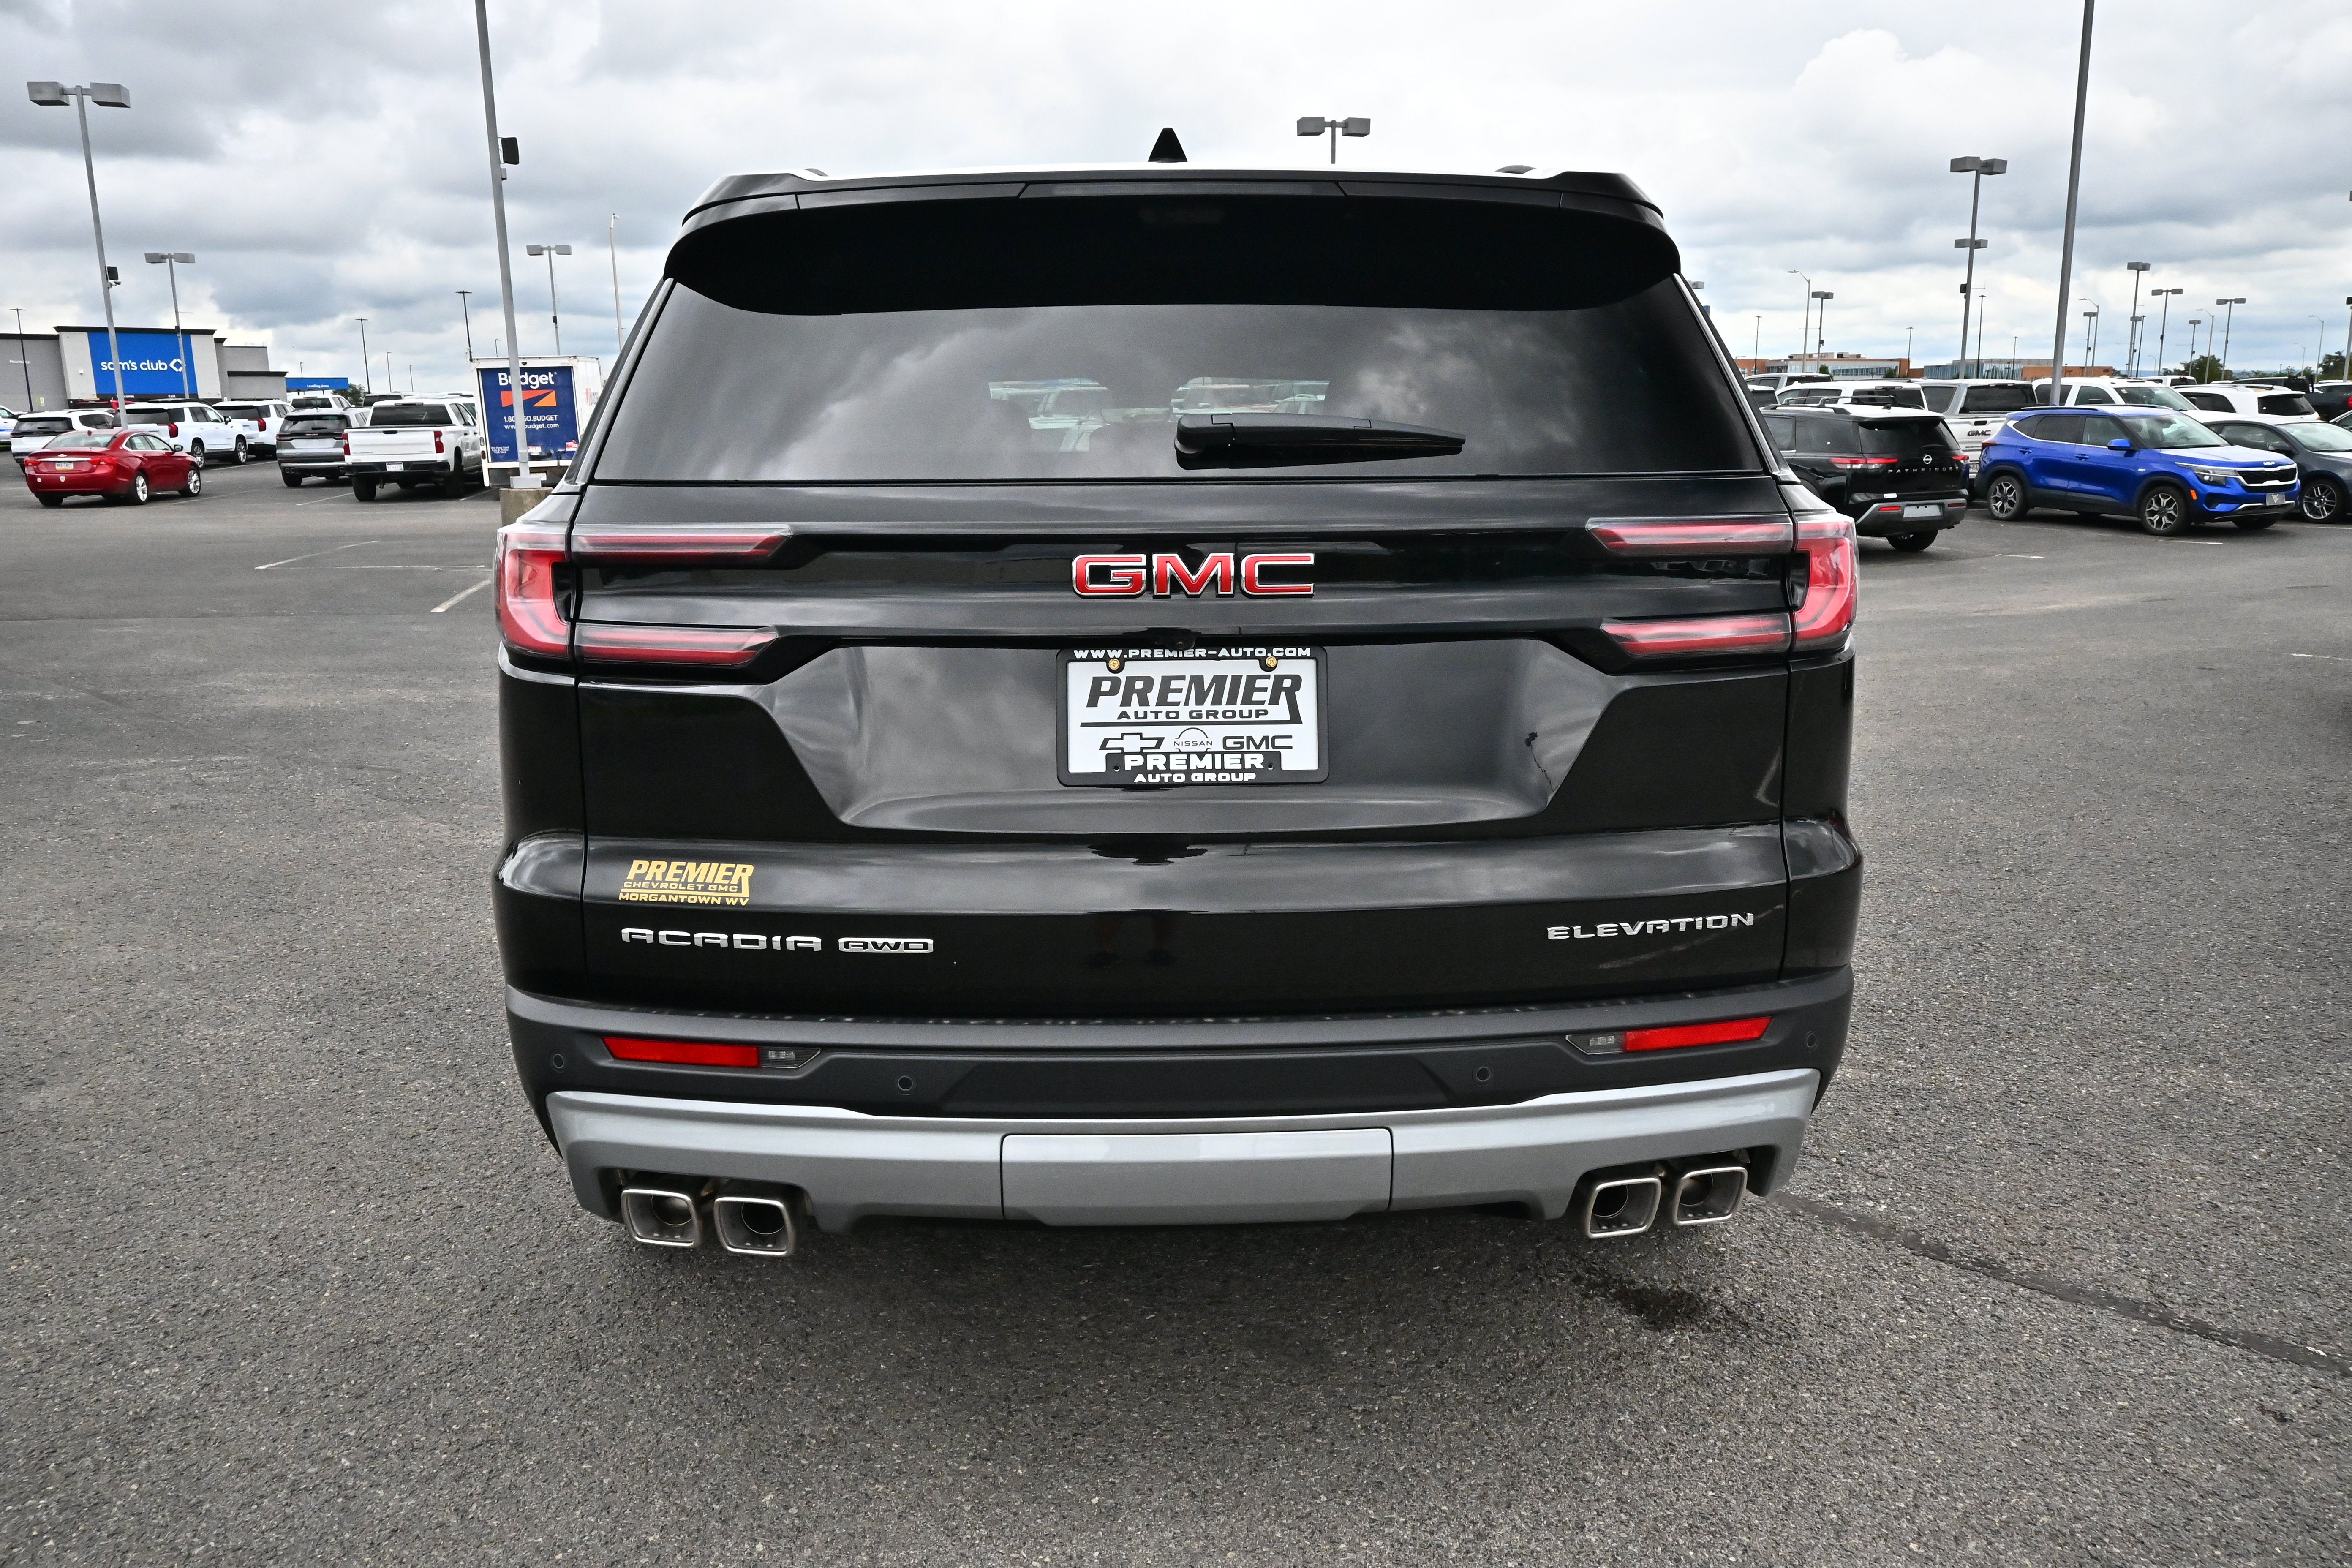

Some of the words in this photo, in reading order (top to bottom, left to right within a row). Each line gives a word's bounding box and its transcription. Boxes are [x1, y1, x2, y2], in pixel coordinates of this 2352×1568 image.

[140, 359, 168, 370] club
[498, 372, 554, 389] Bdget
[1071, 553, 1315, 597] GMC
[1073, 648, 1311, 658] WWW.PREMIER-AUTO.COM
[1086, 674, 1302, 708] PREMIER
[1117, 710, 1179, 719] AUTO
[1189, 709, 1269, 719] GROUP
[1223, 735, 1293, 750] GMC
[1124, 753, 1264, 770] PREMIER
[1134, 773, 1185, 783] AUTO
[1191, 772, 1256, 782] GROUP
[626, 860, 754, 885] PREMIER
[623, 881, 704, 890] CHEVROLET
[708, 884, 738, 892] GMC
[619, 893, 721, 904] MORGANTOWN
[725, 897, 749, 906] WV
[1546, 912, 1754, 940] ELEVATION
[621, 928, 822, 952] ACADIA
[840, 939, 932, 953] AWD
